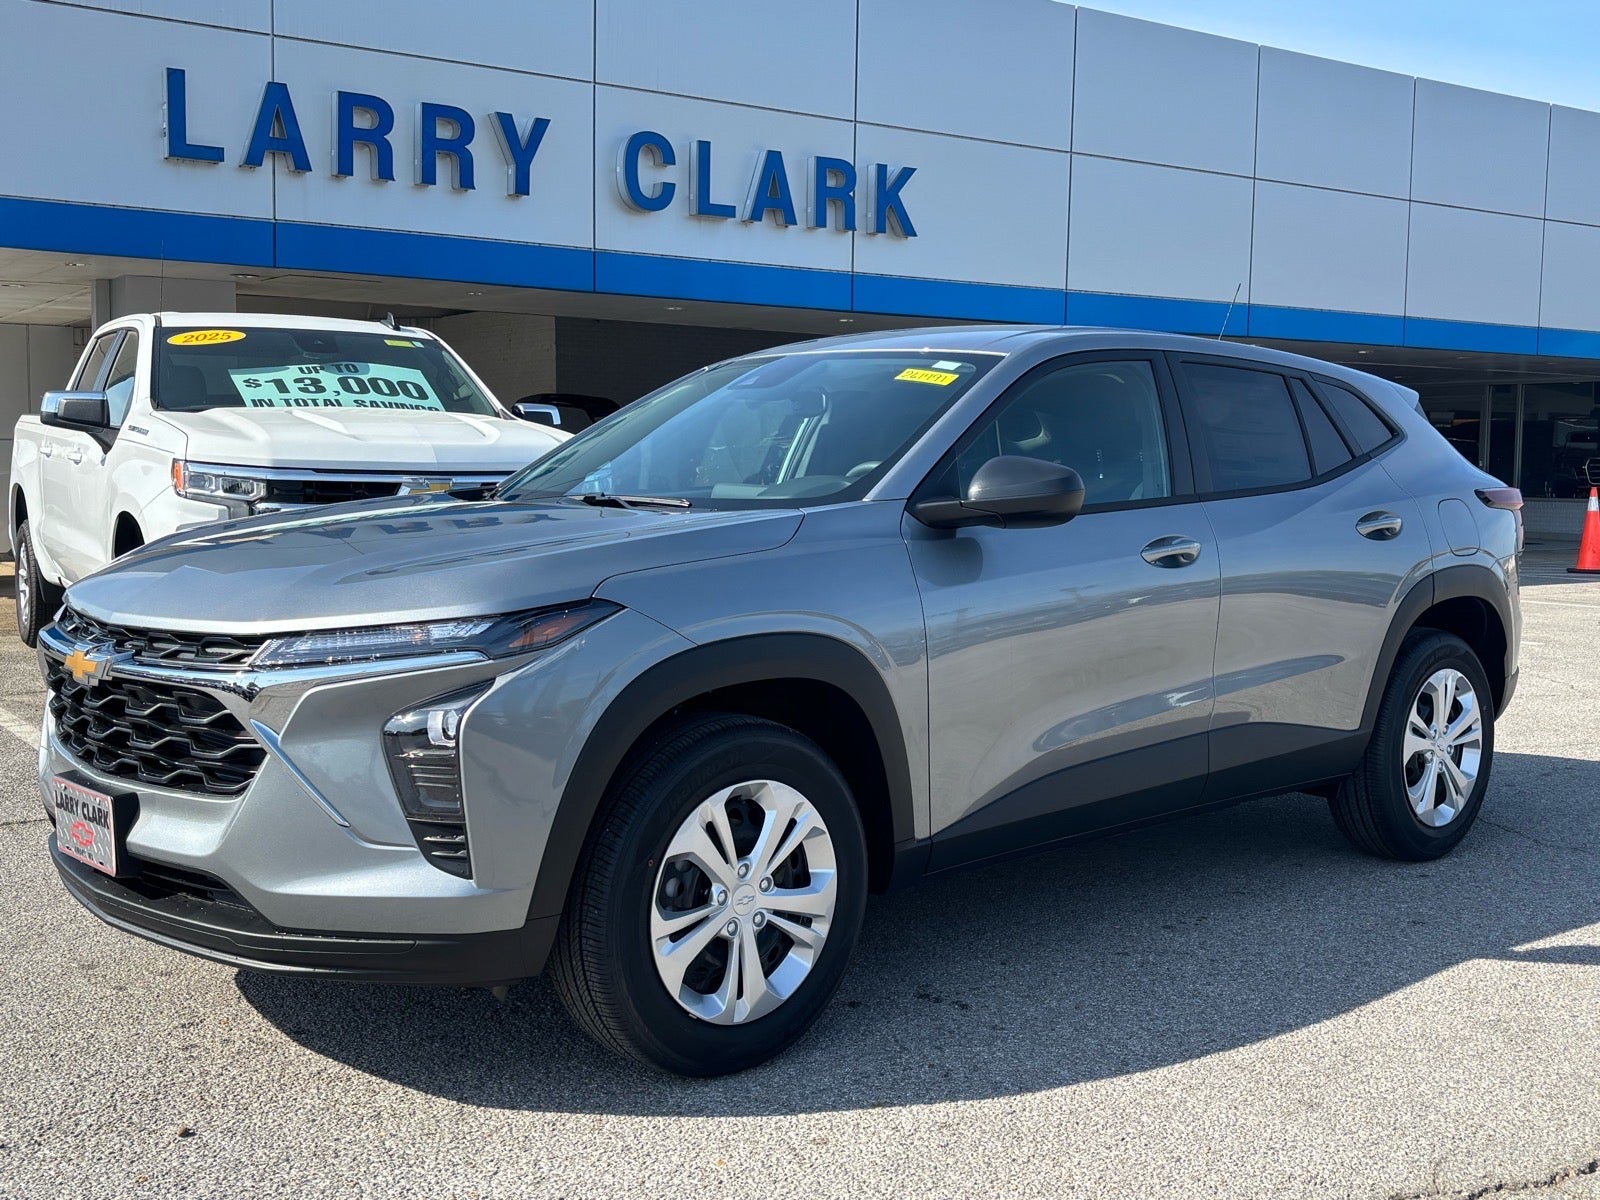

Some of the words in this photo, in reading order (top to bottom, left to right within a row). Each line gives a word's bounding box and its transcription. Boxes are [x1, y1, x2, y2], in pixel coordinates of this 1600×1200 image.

[164, 68, 551, 197] LARRY
[617, 130, 918, 239] CLARK
[182, 332, 232, 343] 2025
[298, 366, 325, 374] UP
[330, 363, 360, 373] TO
[243, 376, 430, 400] $13,000
[250, 398, 273, 407] IN
[55, 790, 79, 817] LARRY
[82, 802, 109, 829] CLARK
